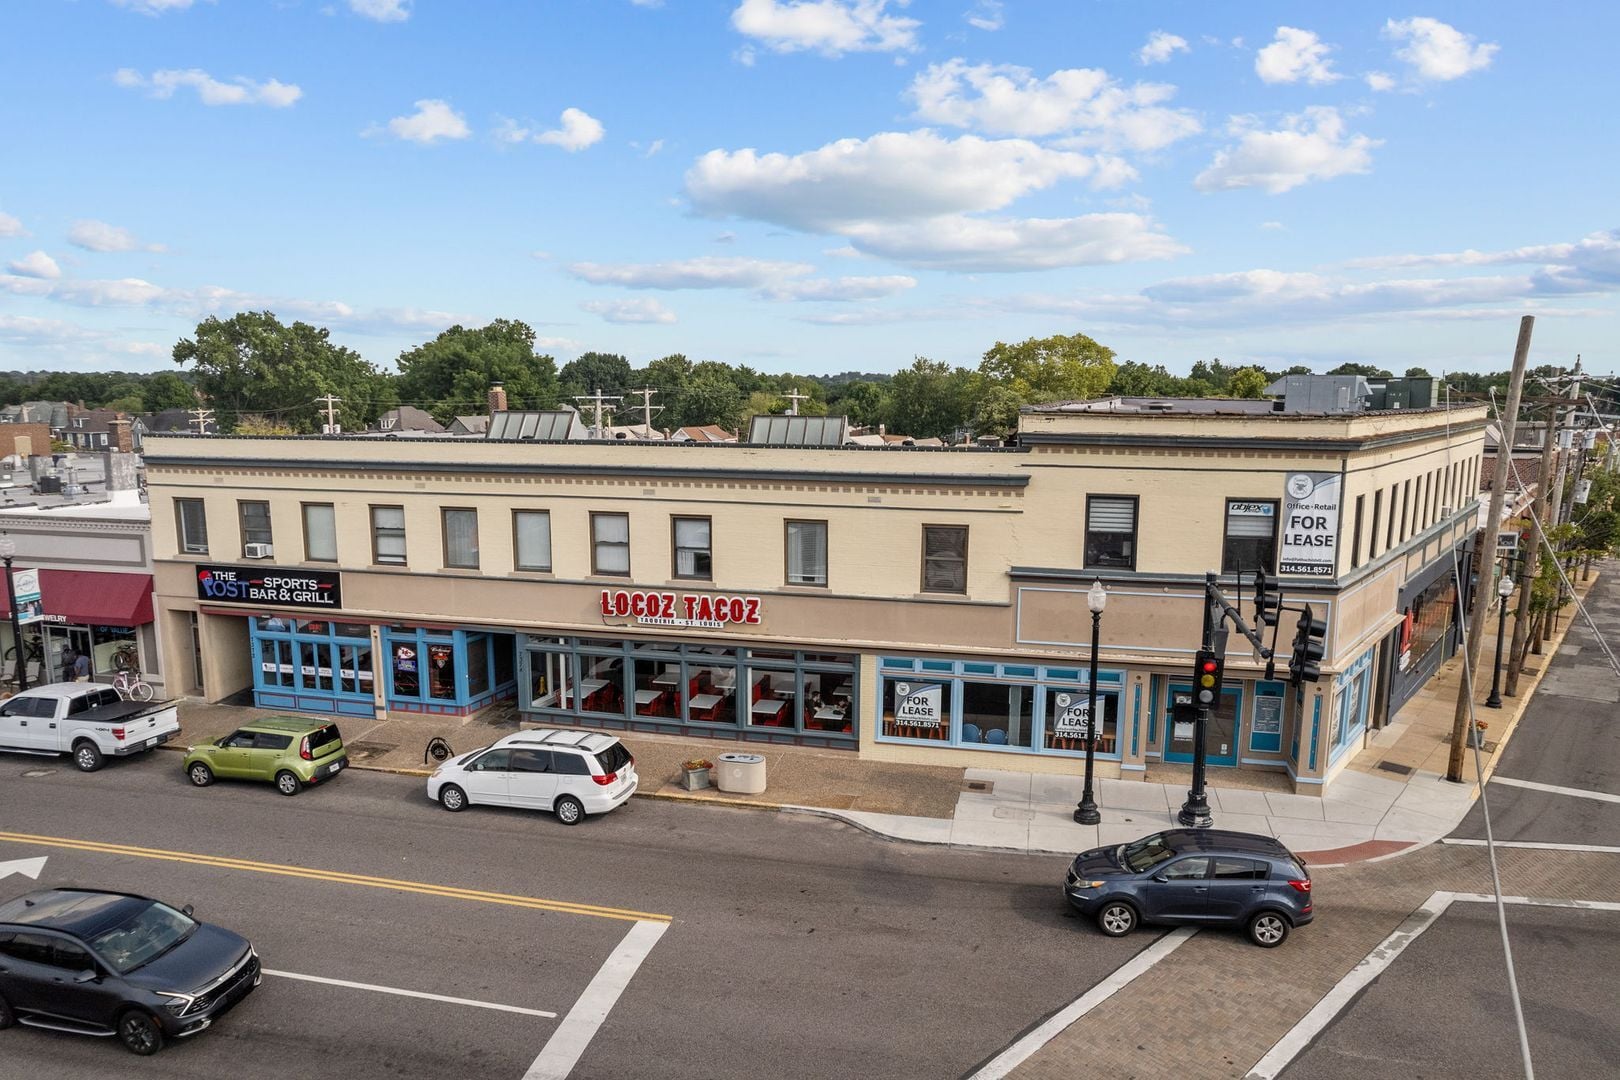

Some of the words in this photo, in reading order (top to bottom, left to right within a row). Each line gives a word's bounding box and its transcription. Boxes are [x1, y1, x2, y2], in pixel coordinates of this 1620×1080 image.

[1286, 502, 1310, 511] Office
[1314, 503, 1337, 511] Retail
[1291, 516, 1327, 530] FOR
[1284, 534, 1334, 547] LEASE
[1280, 565, 1332, 574] 314.561.8571
[212, 570, 237, 581] THE
[263, 577, 318, 590] SPORTS
[249, 588, 278, 600] BAR
[279, 589, 291, 601] &
[293, 592, 334, 604] GRILL
[601, 590, 677, 618] LOCOZ
[683, 596, 761, 624] TACOZ
[640, 617, 675, 625] TAQUERIA
[906, 696, 929, 706] FOR
[902, 706, 934, 717] LEASE
[1067, 707, 1090, 717] FOR
[896, 720, 939, 728] 314.561.8571
[1062, 718, 1089, 727] LEAS
